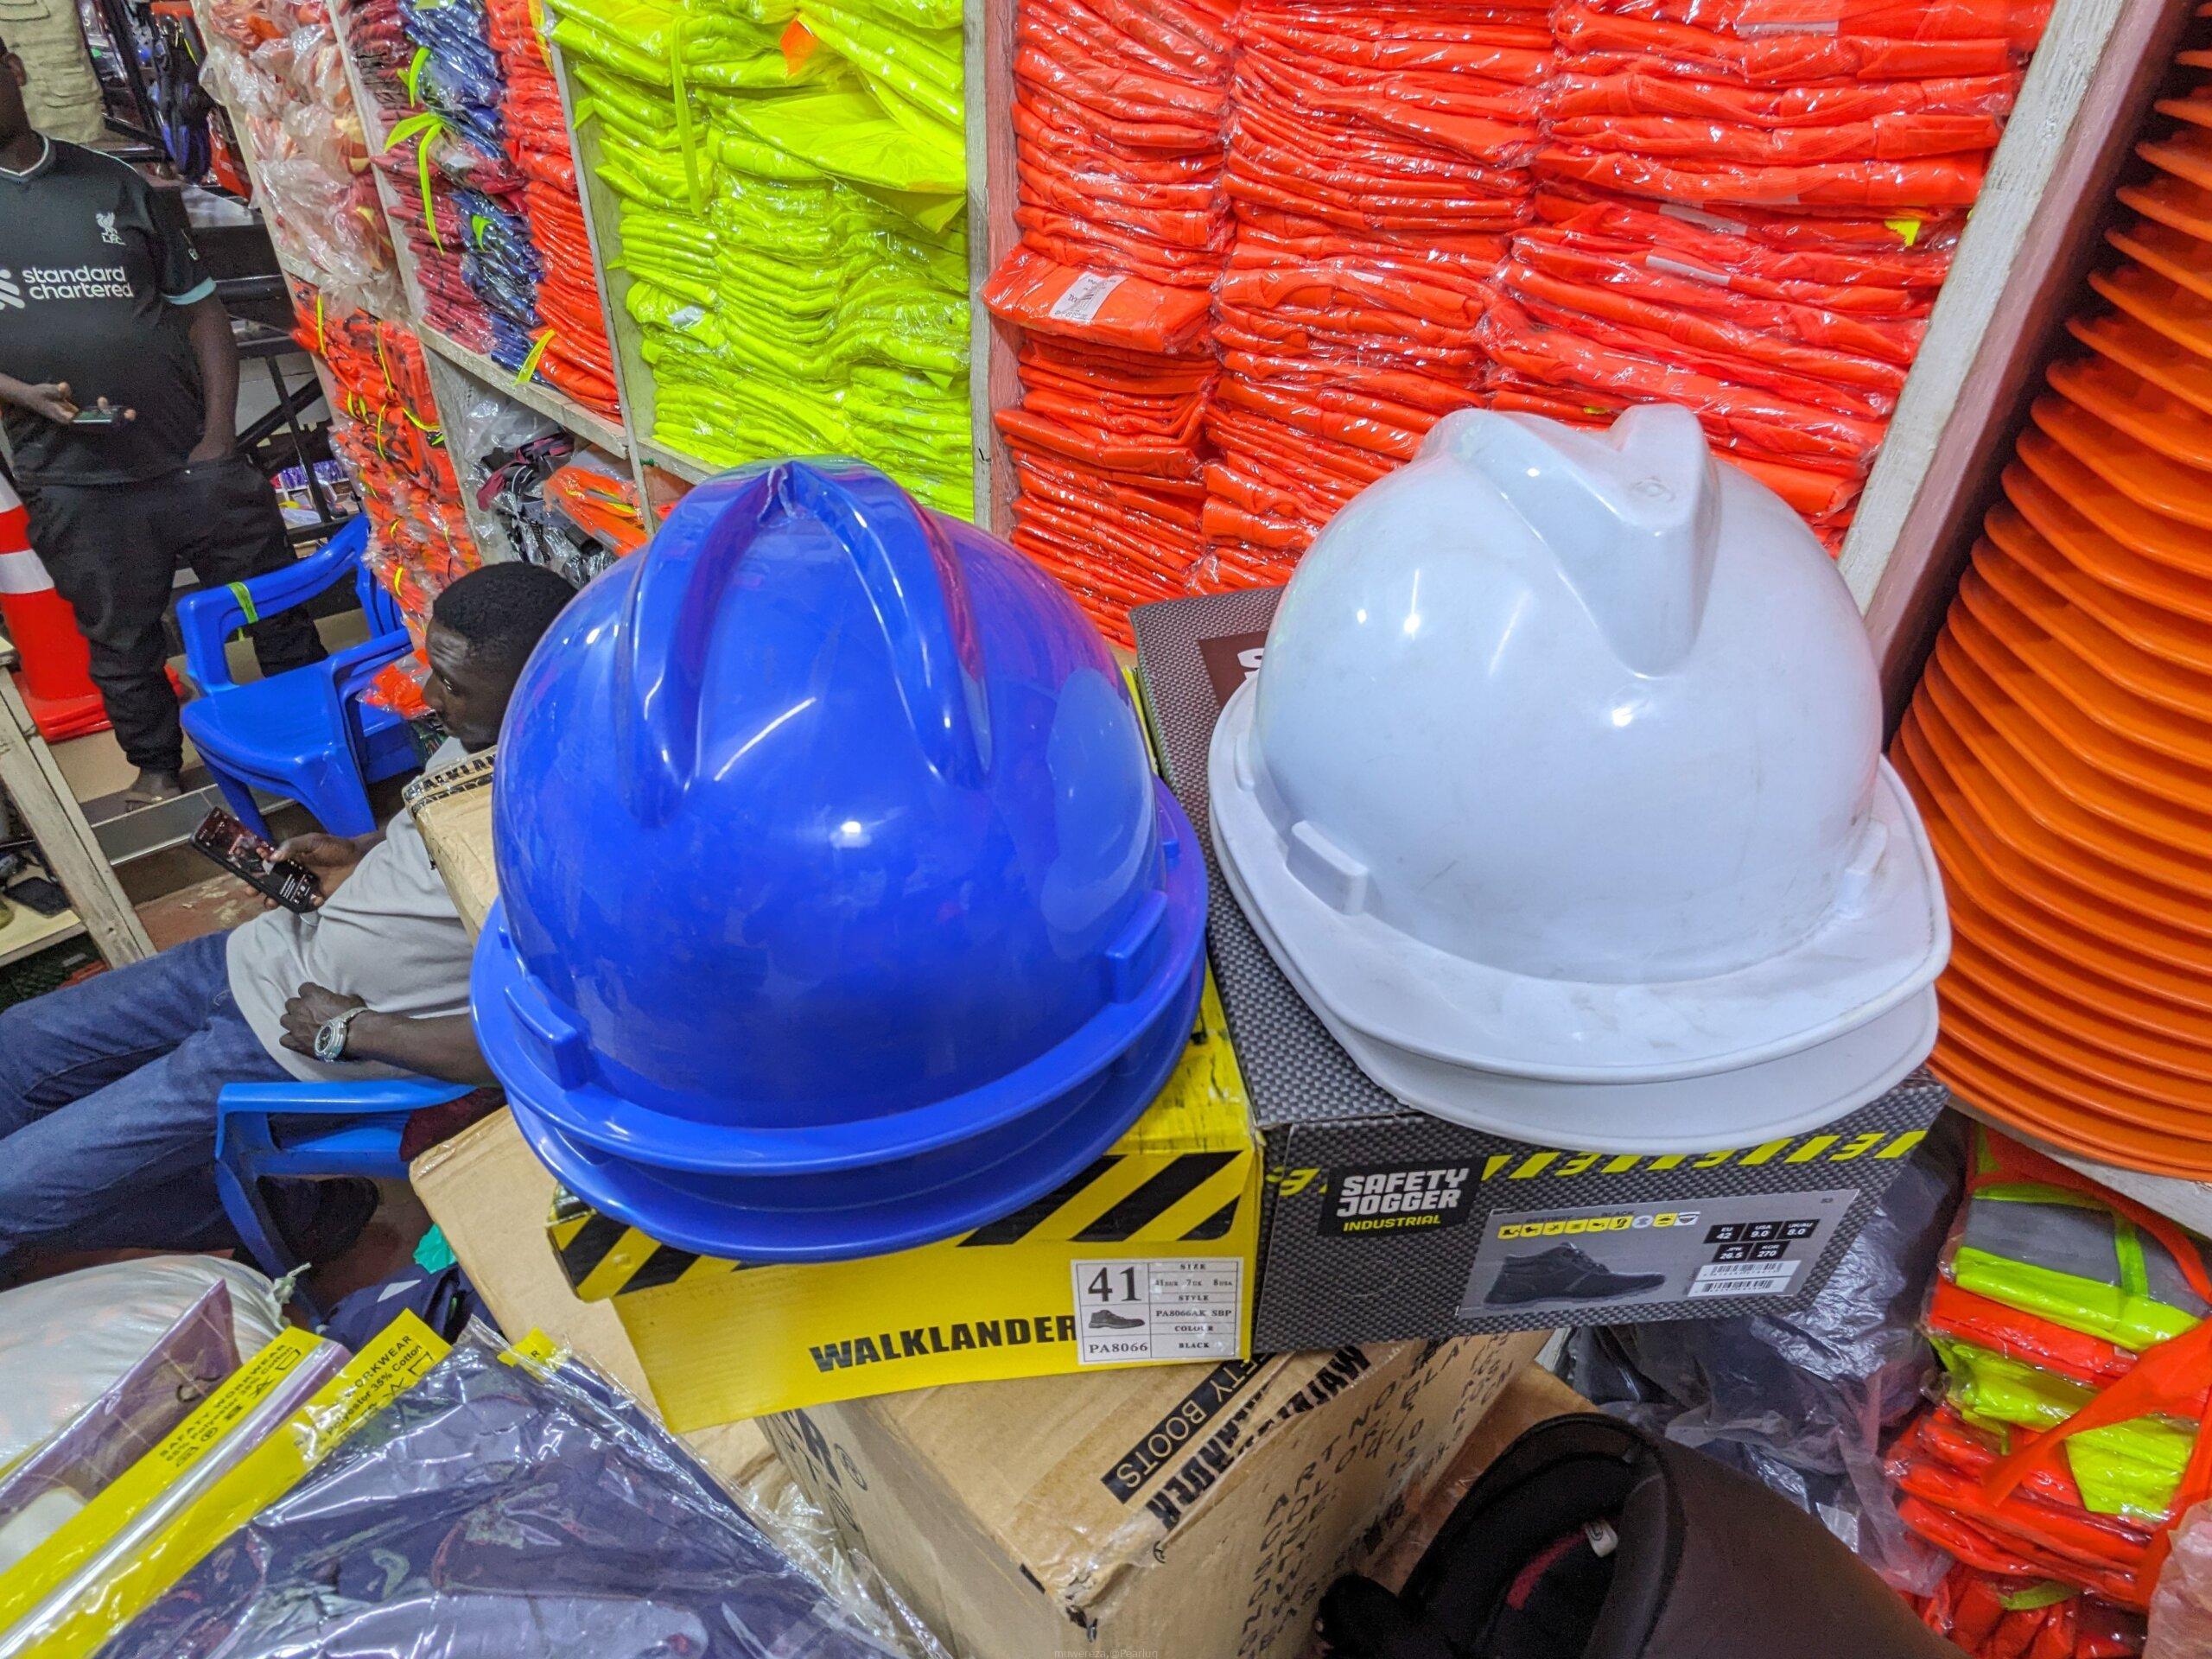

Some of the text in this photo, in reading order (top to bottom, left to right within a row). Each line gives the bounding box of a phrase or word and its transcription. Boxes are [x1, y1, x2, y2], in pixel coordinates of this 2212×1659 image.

[22, 265, 126, 283] standard
[29, 282, 135, 300] chartered
[1341, 1168, 1469, 1198] SAFETY
[1337, 1190, 1461, 1217] JOGGER
[1344, 1214, 1441, 1231] INDUSTRIAL
[1088, 1266, 1142, 1302] 41
[809, 1314, 1077, 1372] WALKLANDER
[1090, 1343, 1148, 1354] PA8066
[214, 1344, 286, 1409] WORKWEAR
[371, 1373, 393, 1392] 35%
[392, 1344, 423, 1372] Cotton
[1116, 1400, 1208, 1489] BOOTS
